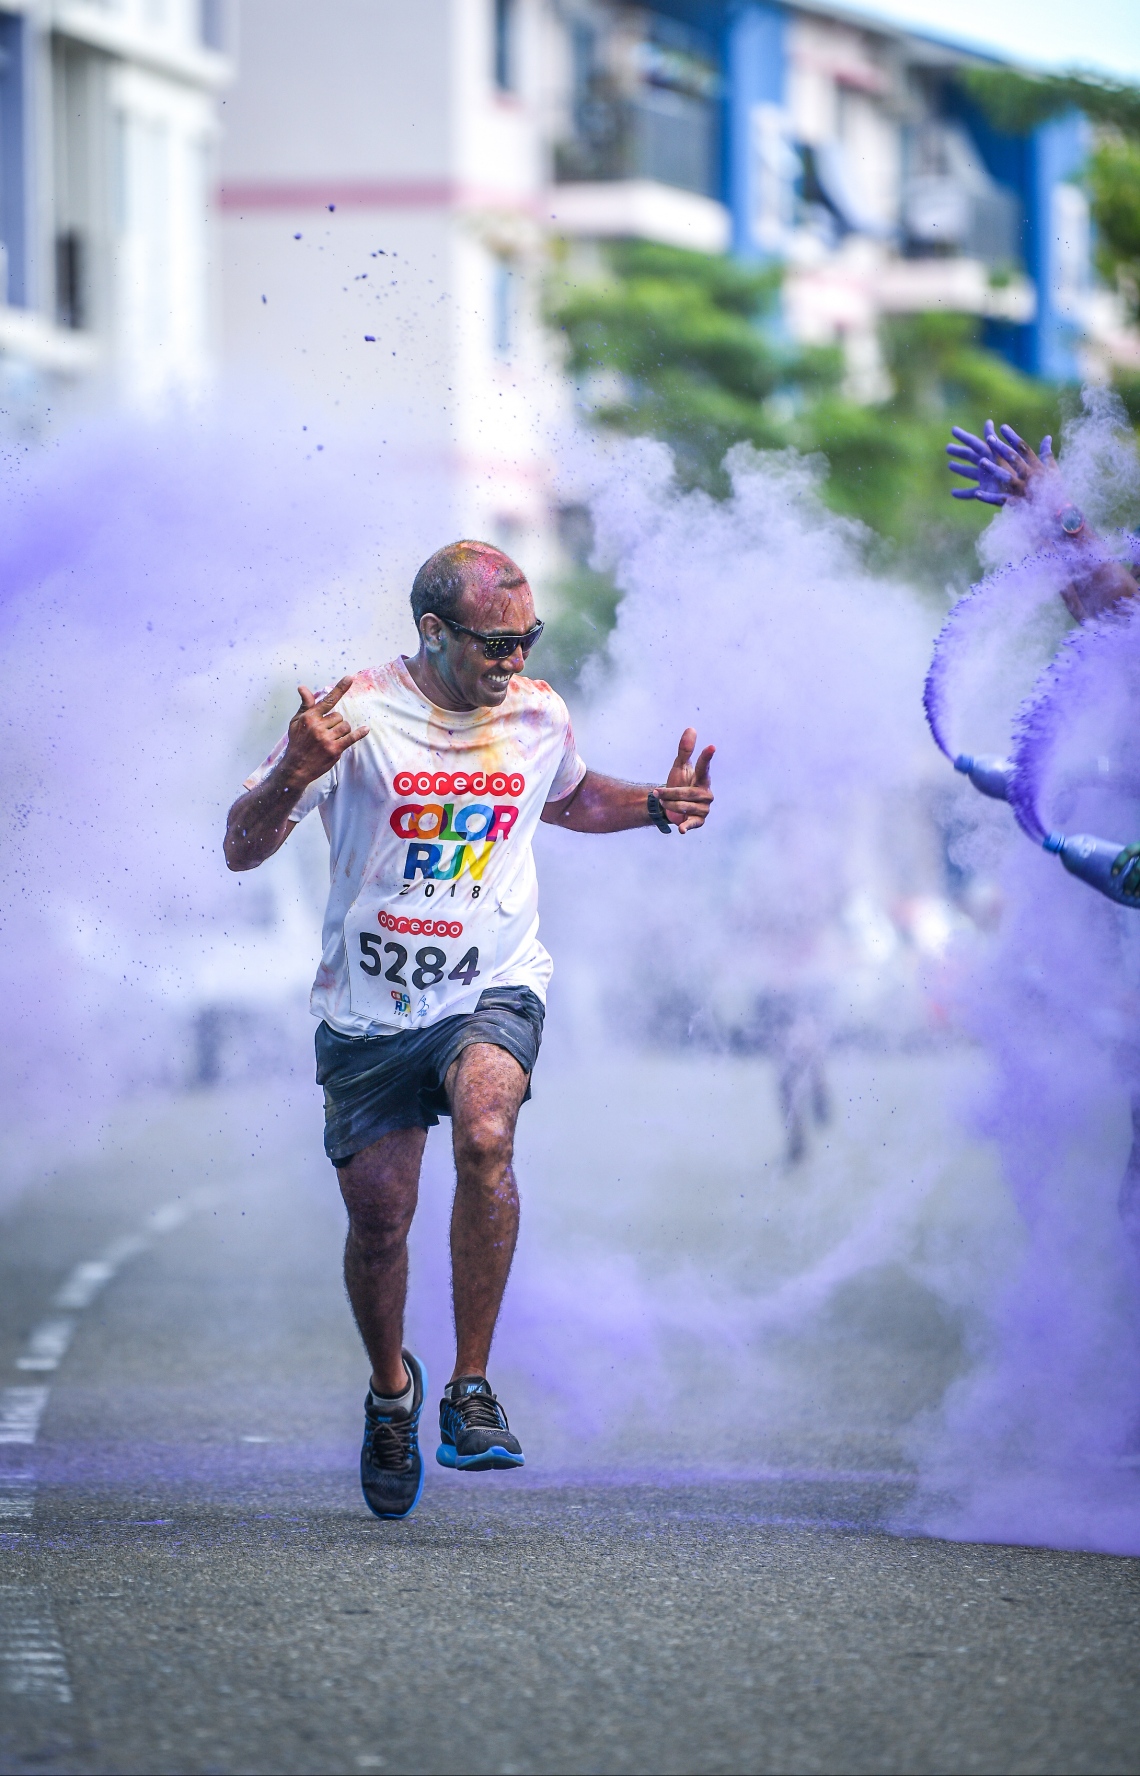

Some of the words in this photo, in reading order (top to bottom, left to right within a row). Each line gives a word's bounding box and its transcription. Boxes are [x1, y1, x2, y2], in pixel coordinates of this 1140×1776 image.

[395, 772, 524, 796] ooredoo
[390, 804, 519, 841] COLOR
[404, 841, 495, 880] RUN
[399, 884, 481, 899] 2018
[378, 911, 463, 938] ooredoo
[360, 932, 480, 990] 5284
[391, 990, 410, 1004] COLO
